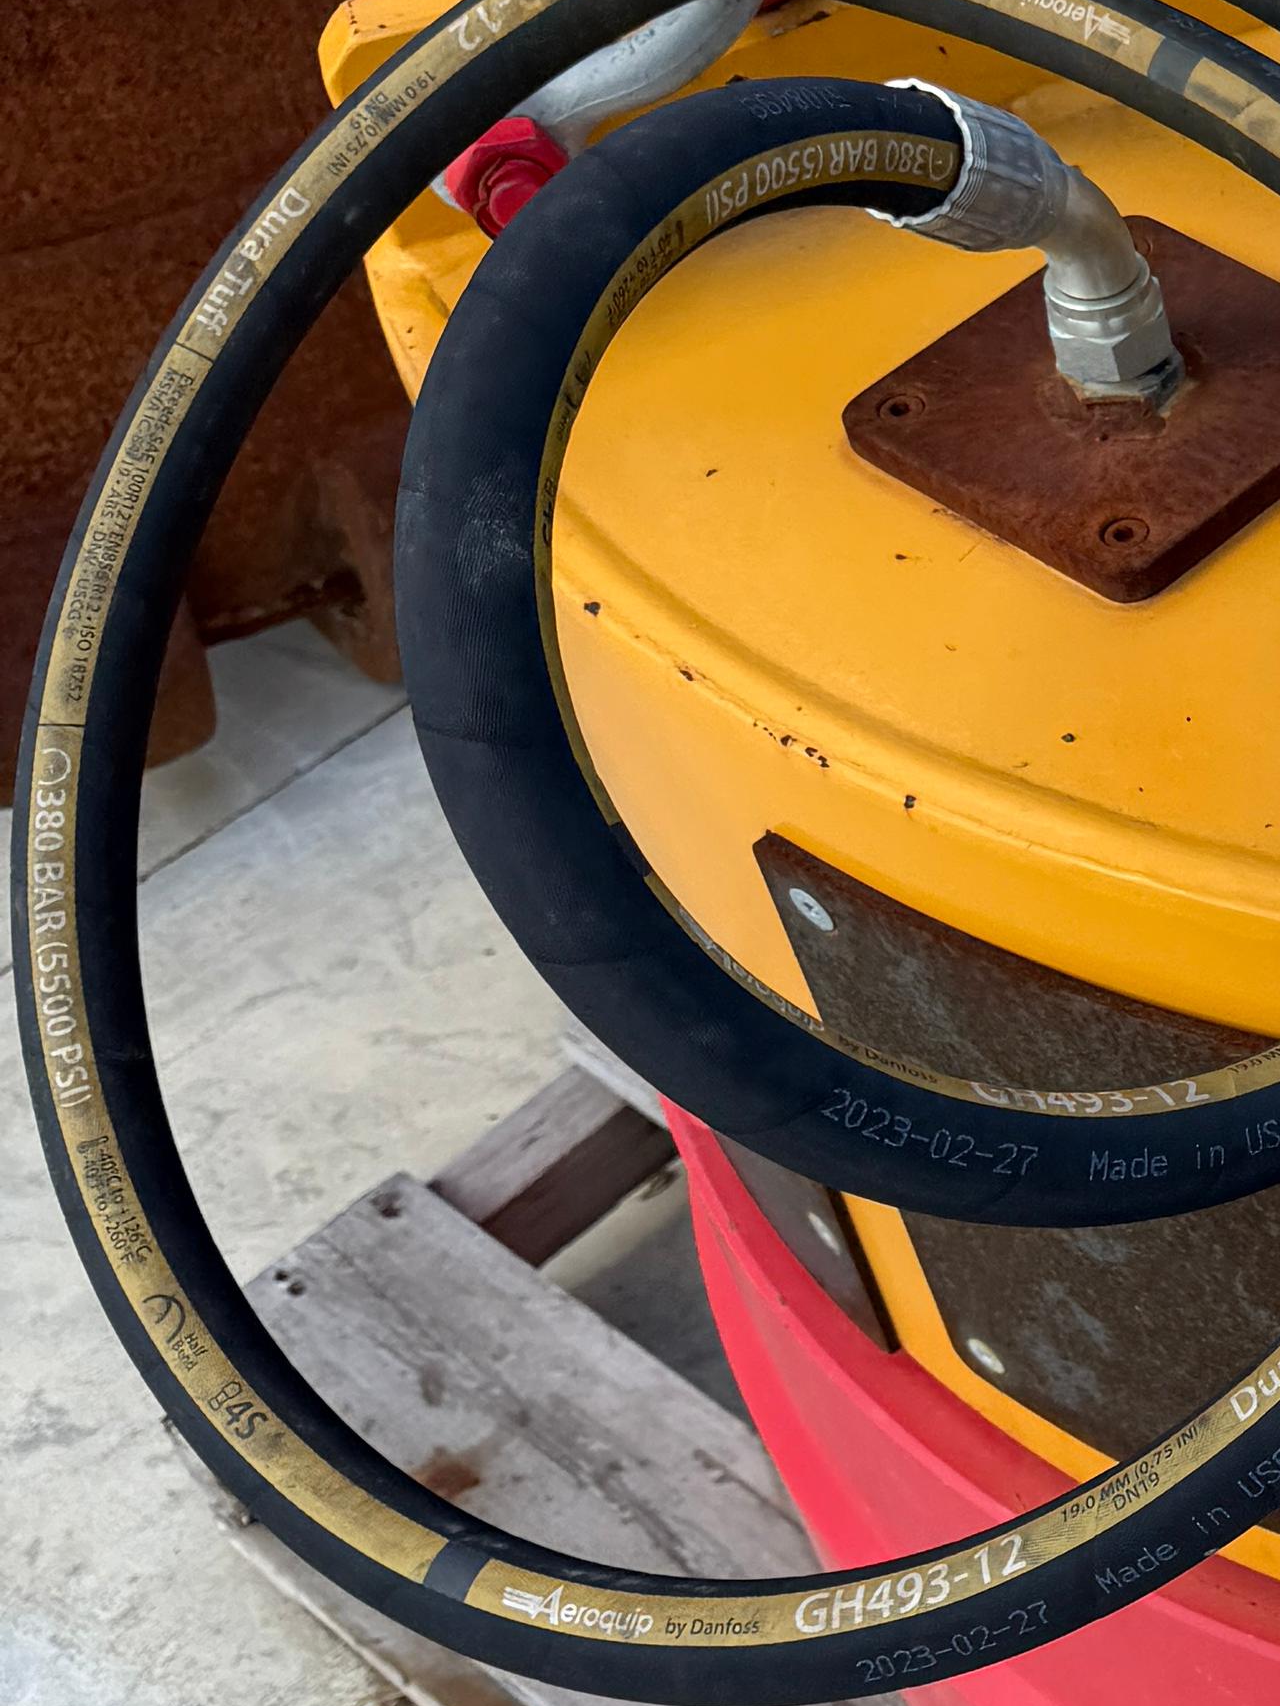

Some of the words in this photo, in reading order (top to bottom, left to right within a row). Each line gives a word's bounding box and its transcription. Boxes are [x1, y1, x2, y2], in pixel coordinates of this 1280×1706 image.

[755, 144, 824, 197] (5500
[829, 139, 877, 175] BAR
[884, 141, 930, 175] 380
[195, 185, 312, 337] Dura-Tuff
[76, 623, 97, 652] ISO
[64, 656, 90, 703] 18752
[33, 787, 66, 853] 380
[32, 861, 66, 934] BAR
[35, 941, 75, 1038] (5500
[49, 1041, 93, 1109] PSI)
[970, 1078, 1210, 1115] GH493-12
[820, 1087, 1040, 1177] 2023-02-27
[1089, 1147, 1170, 1182] Made
[1194, 1142, 1226, 1171] in
[226, 1399, 269, 1441] 4S
[1060, 1495, 1096, 1524] 19.0
[1099, 1472, 1132, 1502] MM
[1111, 1470, 1161, 1513] DN19
[501, 1584, 654, 1638] Aeroquip
[664, 1617, 686, 1639] by
[689, 1616, 761, 1637] Danfoss
[794, 1533, 1028, 1635] GH493-12
[855, 1600, 1050, 1683] 2023-02-27
[1094, 1541, 1180, 1595] Made
[1190, 1504, 1231, 1535] in
